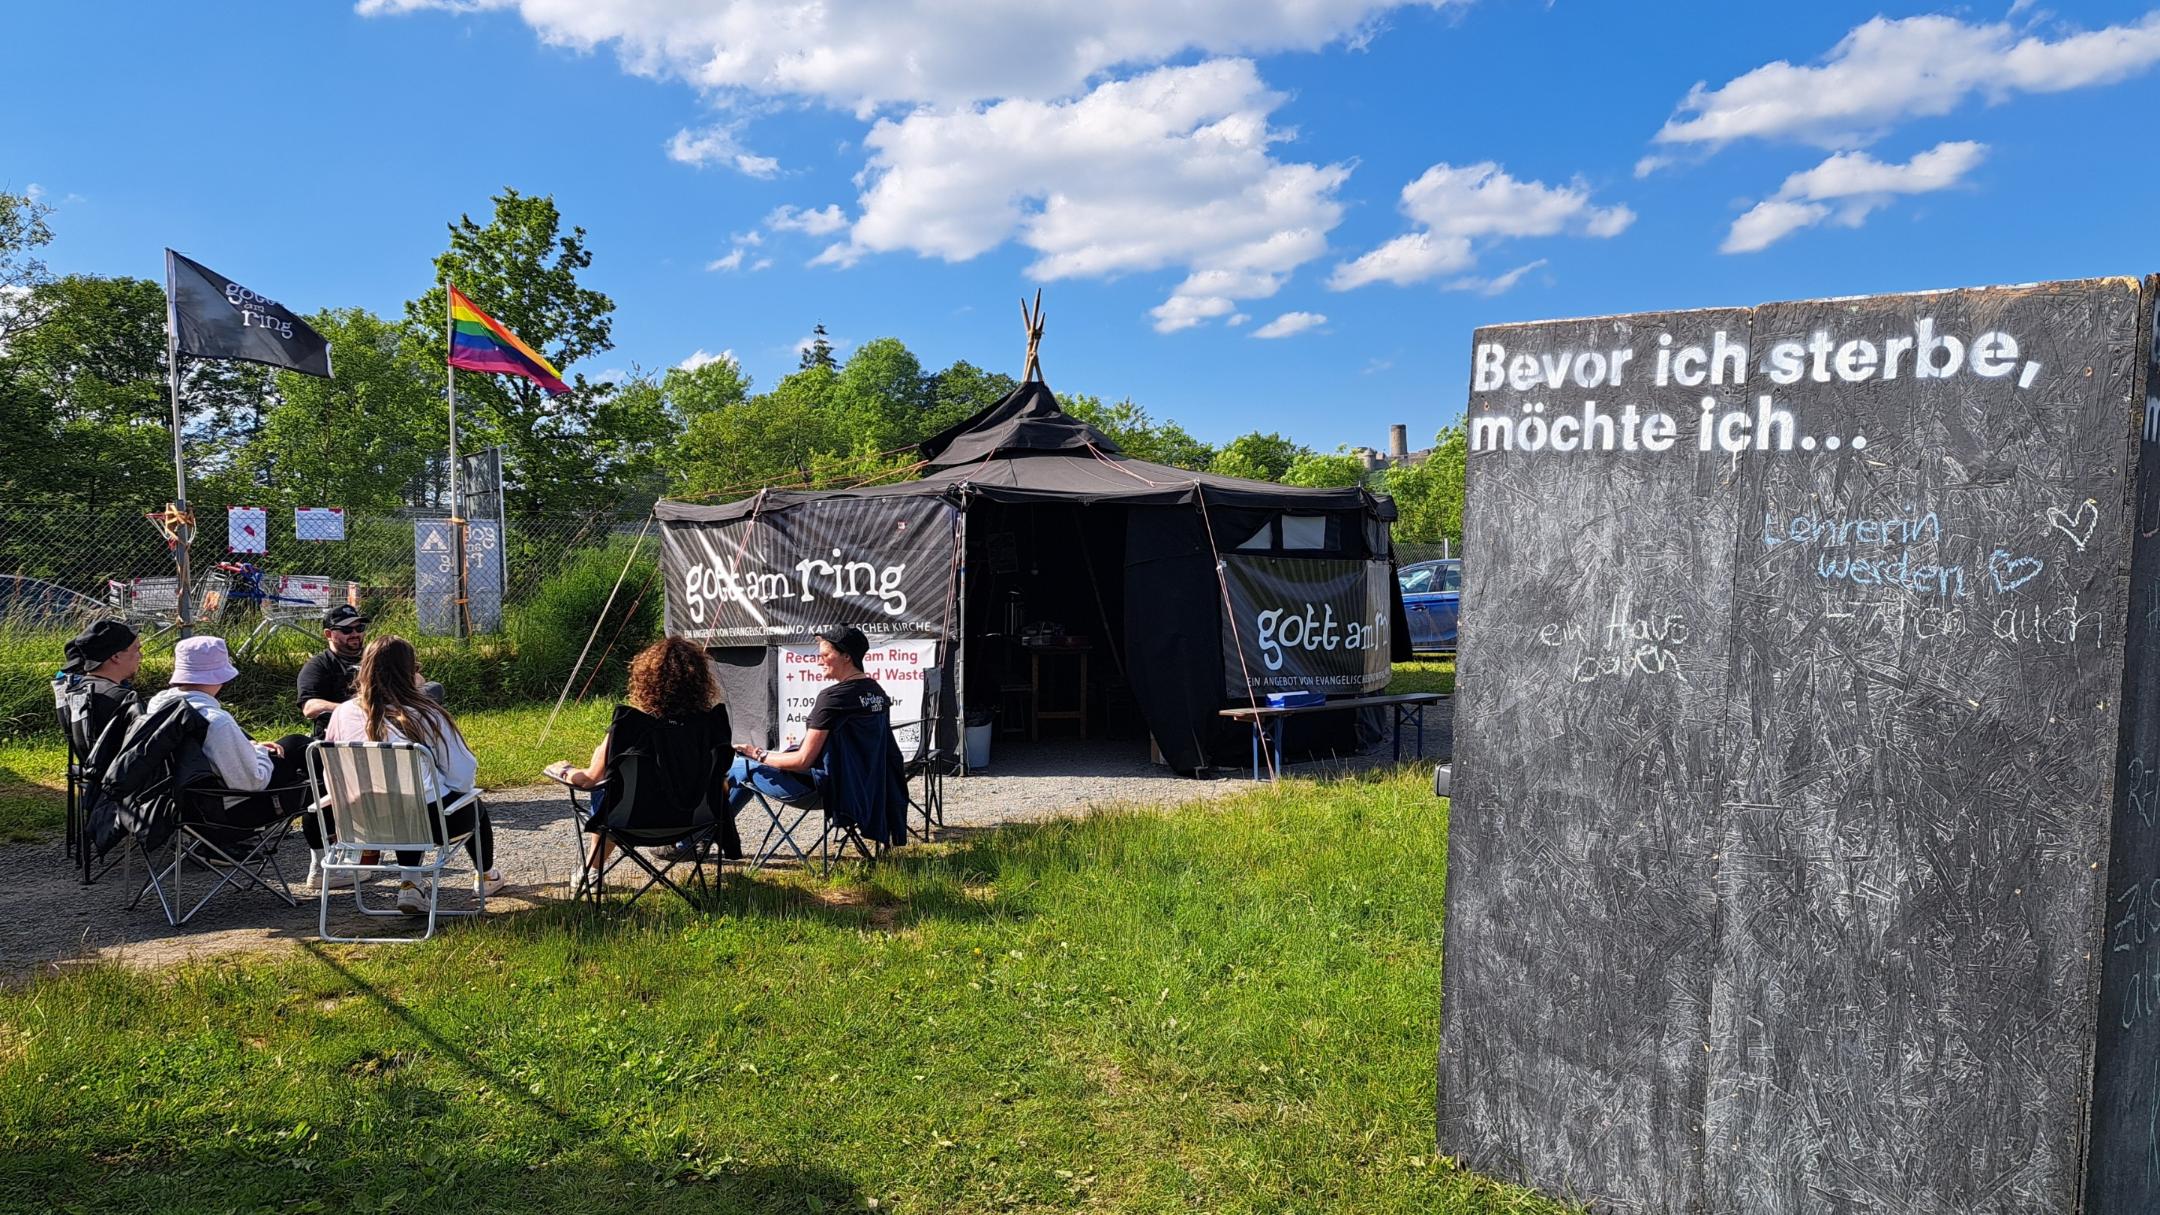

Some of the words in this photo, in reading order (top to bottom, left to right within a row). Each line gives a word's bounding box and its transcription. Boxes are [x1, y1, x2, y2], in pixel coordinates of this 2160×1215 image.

[241, 309, 293, 340] ring
[1474, 343, 1633, 392] Bevor
[1656, 332, 1747, 387] ich
[1761, 317, 2042, 389] sterbe,
[1471, 401, 1677, 452] möchte
[745, 571, 797, 604] am
[795, 548, 908, 616] ring
[892, 621, 931, 634] KIRCHE
[1257, 602, 1341, 671] gott
[1344, 622, 1375, 650] am
[889, 649, 918, 665] Ring
[885, 668, 924, 681] Waste
[1248, 676, 1261, 687] EIN
[1263, 675, 1297, 687] ANGEBOT
[1299, 675, 1314, 686] VON
